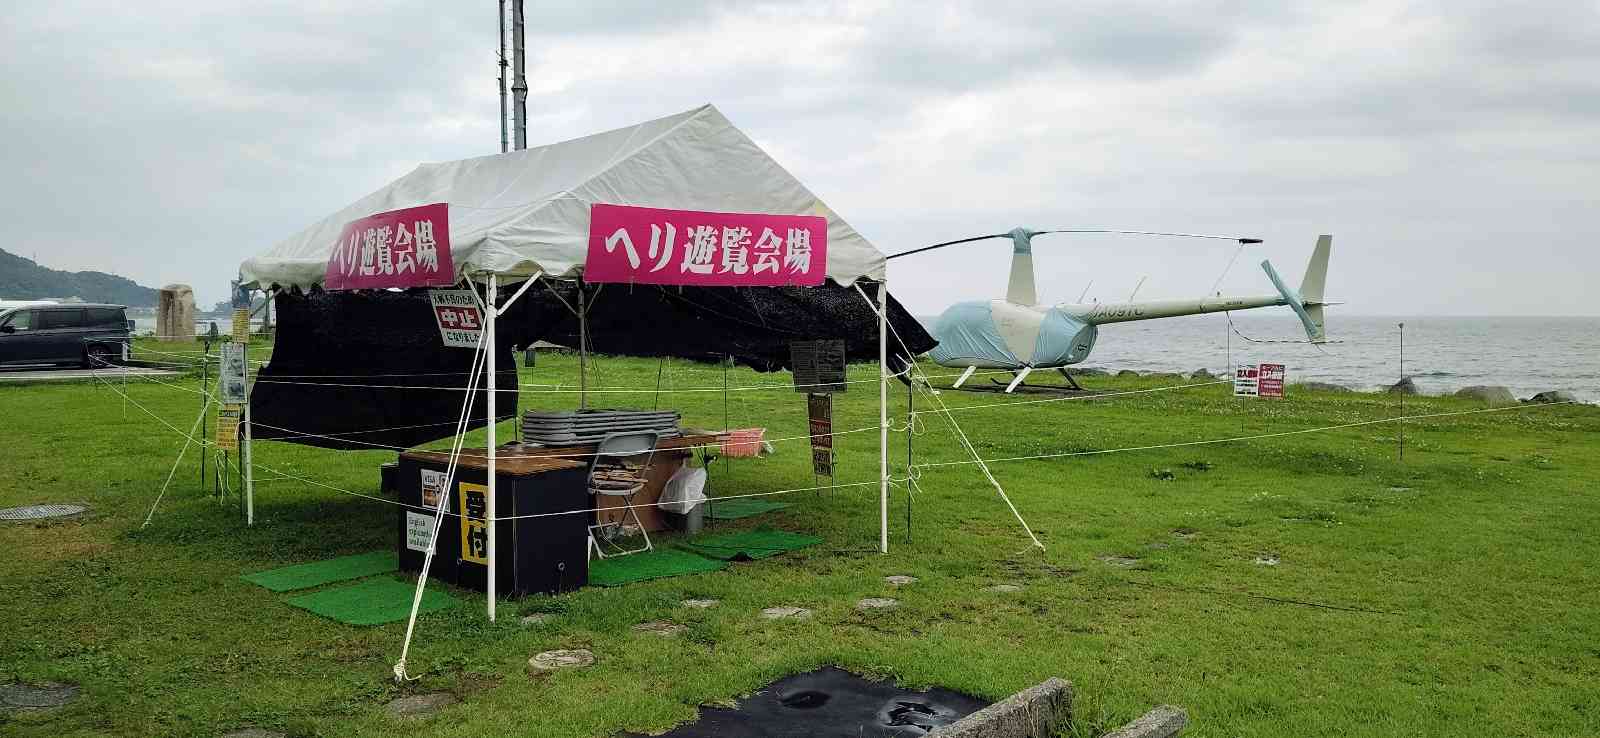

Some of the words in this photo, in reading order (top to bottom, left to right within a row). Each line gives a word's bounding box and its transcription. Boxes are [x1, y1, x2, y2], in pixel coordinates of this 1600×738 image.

[332, 218, 438, 278] ヘリ遊覧会場
[605, 222, 812, 275] ヘリ遊覧会場
[440, 309, 478, 328] 中止
[465, 490, 488, 558] 受付
